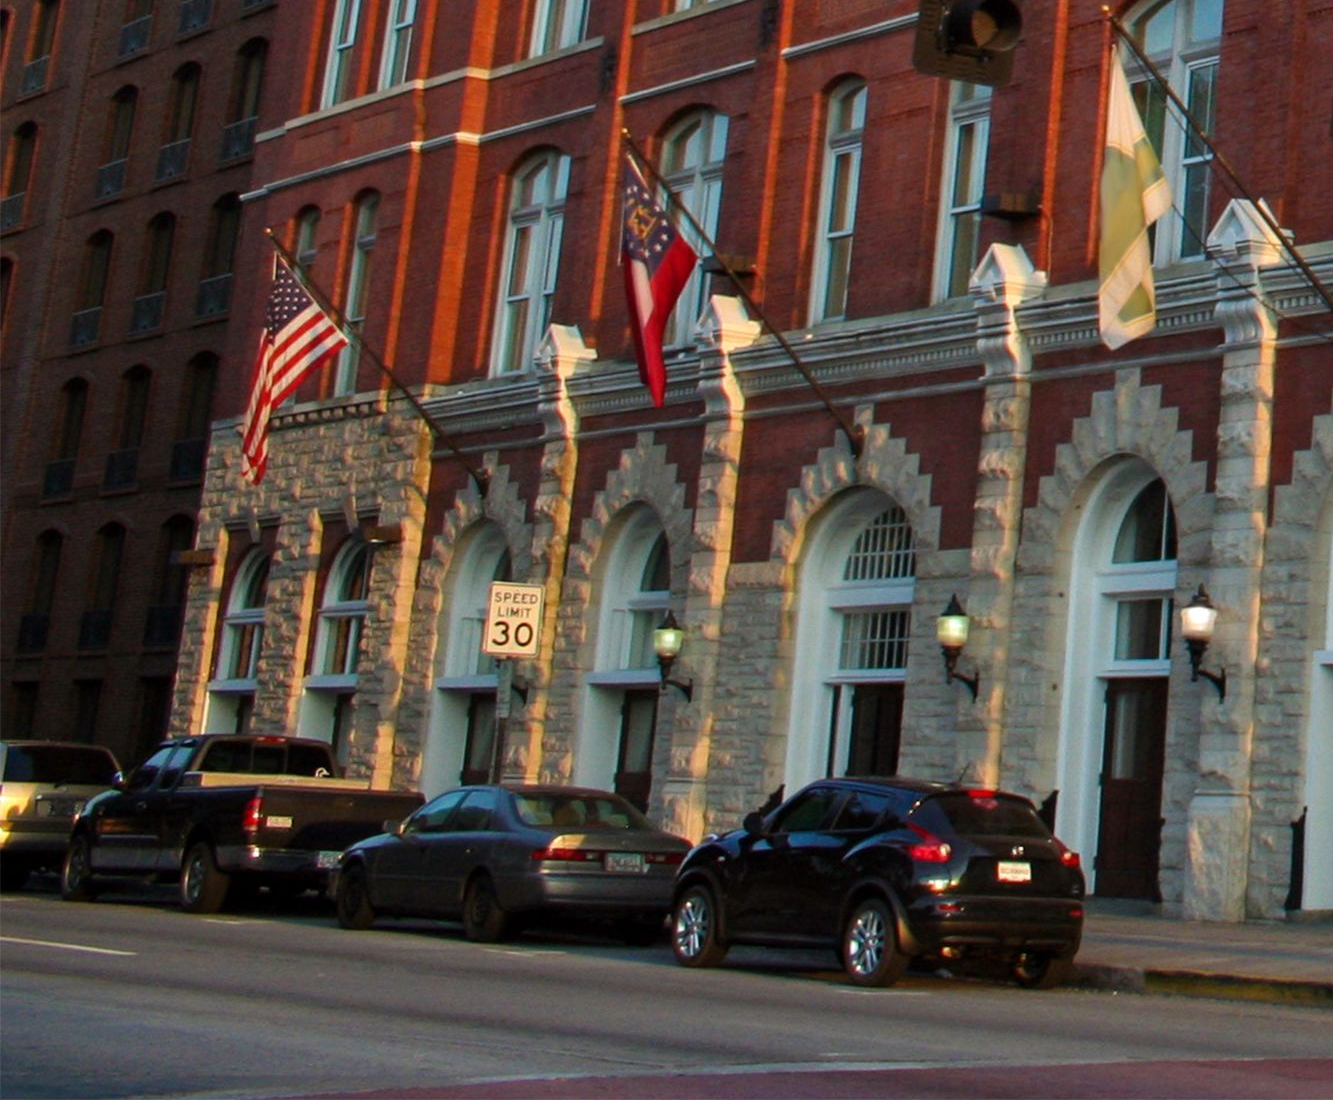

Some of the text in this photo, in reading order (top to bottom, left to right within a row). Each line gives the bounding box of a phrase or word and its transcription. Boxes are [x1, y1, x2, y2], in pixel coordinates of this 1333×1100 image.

[495, 592, 539, 604] SPEED
[498, 606, 531, 618] LIMIT
[492, 621, 533, 647] 30
